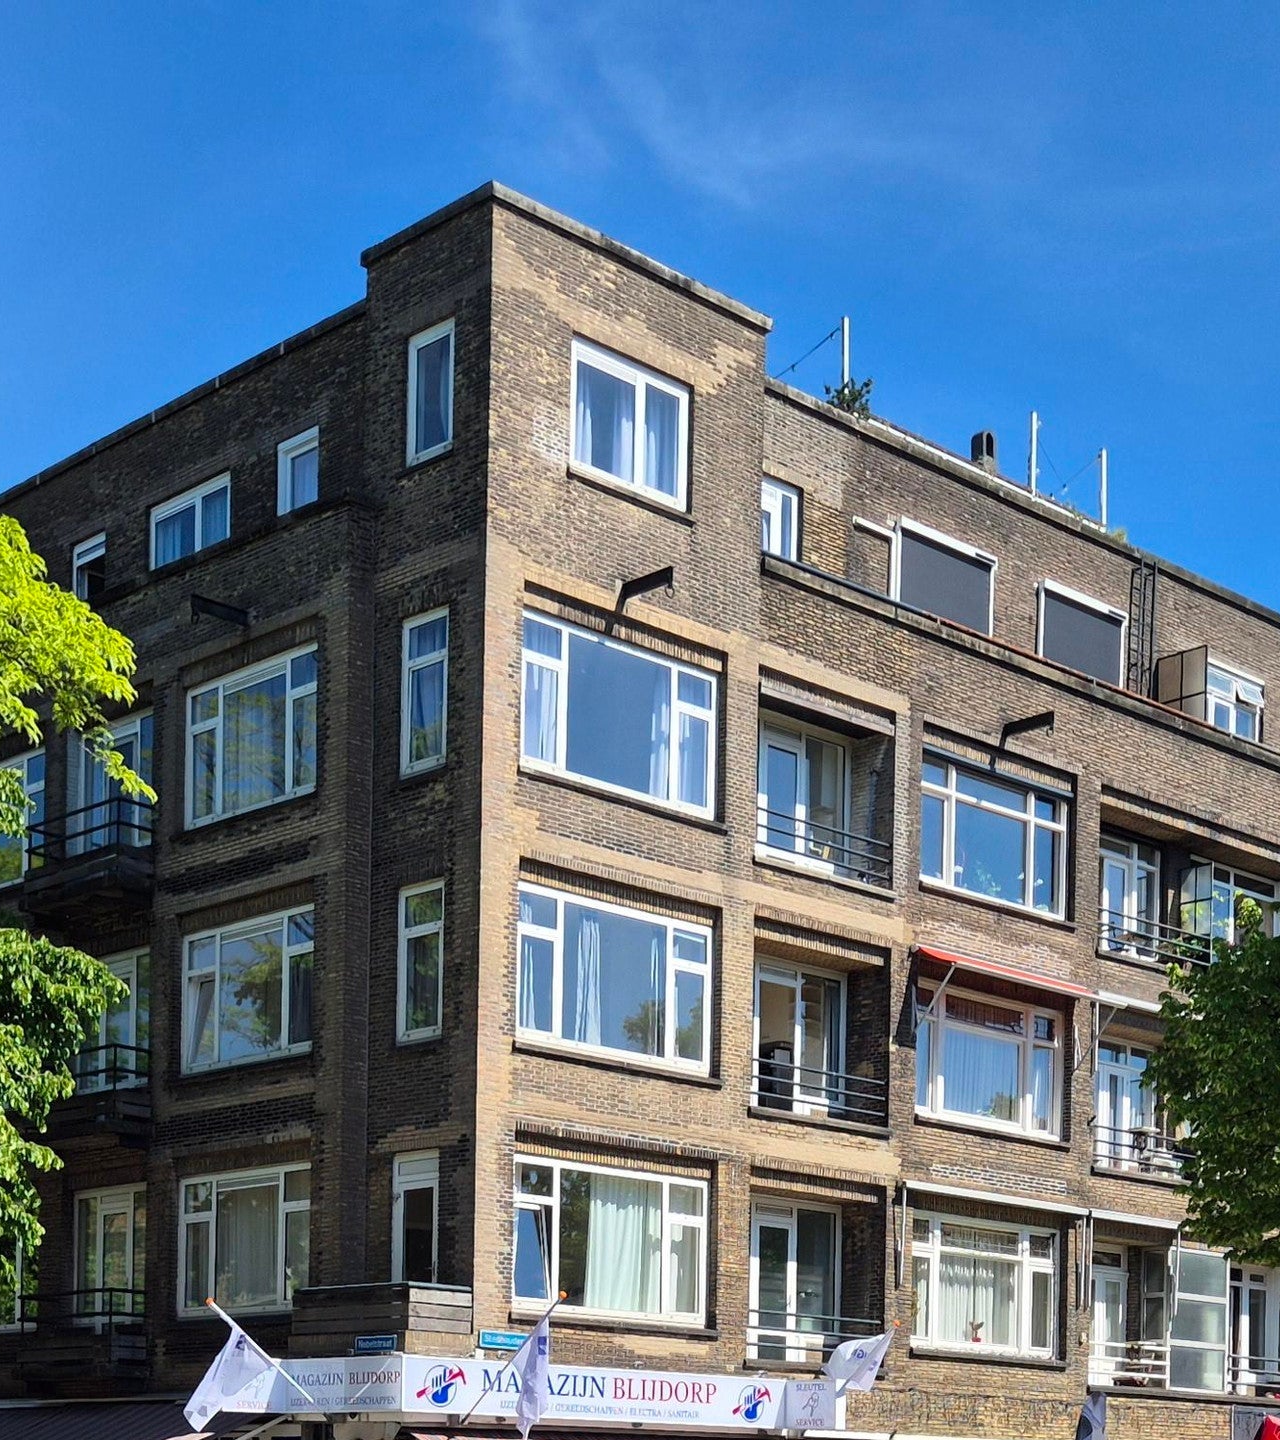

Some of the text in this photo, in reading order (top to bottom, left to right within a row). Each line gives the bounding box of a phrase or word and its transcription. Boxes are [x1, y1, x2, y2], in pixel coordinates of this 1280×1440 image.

[349, 1370, 401, 1386] BLIJDORP
[481, 1368, 718, 1404] MAAZIJN BLIJDORP
[795, 1382, 827, 1391] SLEUTEL
[629, 1408, 662, 1418] ELECTRA
